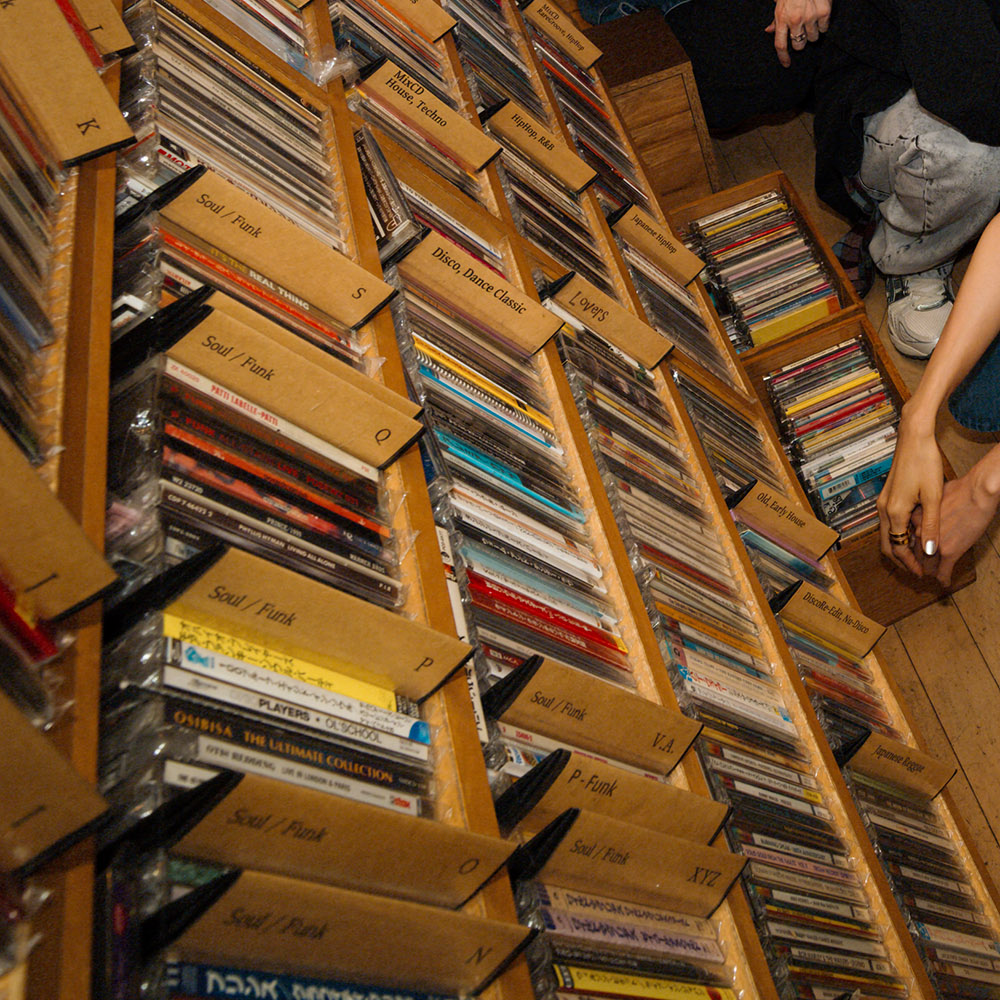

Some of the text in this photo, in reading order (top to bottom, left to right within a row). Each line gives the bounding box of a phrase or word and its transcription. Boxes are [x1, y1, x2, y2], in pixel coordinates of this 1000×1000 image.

[565, 32, 585, 51] HipHop
[393, 70, 425, 96] MixCD
[385, 77, 448, 127] House, Techno
[77, 118, 101, 136] K
[511, 113, 556, 152] HipHop, R&B
[196, 193, 263, 239] Soul Funk
[631, 214, 677, 254] Japanese HipHop
[248, 269, 310, 310] REAL THING
[351, 287, 367, 300] S
[432, 247, 527, 315] Disco, Dance Classic
[568, 291, 609, 322] Lovers
[201, 336, 275, 381] Soul Funk
[374, 428, 392, 445] Q
[757, 492, 806, 528] Old, Early House
[207, 585, 297, 627] Soul Funk
[841, 613, 869, 635] Nu-Disco
[414, 656, 434, 672] P
[258, 698, 310, 723] PLAYERS
[530, 691, 588, 722] Soul Funk
[174, 710, 394, 784] OSIBISA THE ULTIMATE COLLECTION
[652, 733, 674, 754] V.A.
[871, 744, 926, 774] Japanese Reggae
[226, 808, 329, 843] Soul Funk
[457, 858, 480, 875] O
[569, 839, 629, 866] Soul Funk
[686, 866, 722, 888] XYZ
[223, 908, 329, 940] Soul Funk
[465, 946, 493, 965] N
